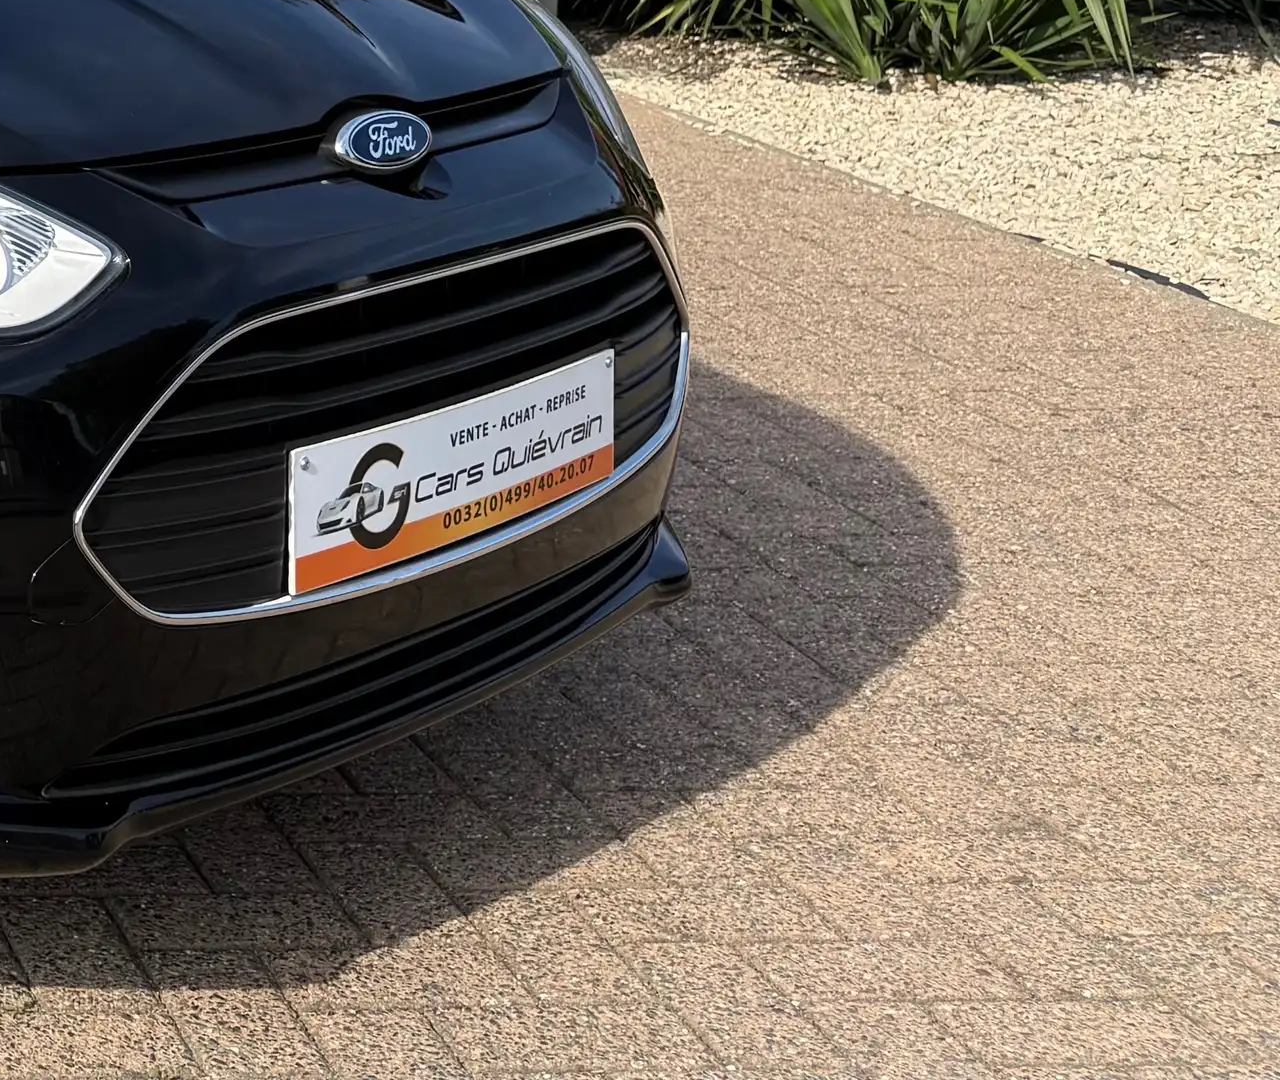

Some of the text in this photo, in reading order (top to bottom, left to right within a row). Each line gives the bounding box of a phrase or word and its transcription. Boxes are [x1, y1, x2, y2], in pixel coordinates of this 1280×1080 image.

[368, 120, 417, 159] Ford
[450, 421, 490, 448] VENTE
[500, 404, 537, 432] ACHAT
[546, 384, 587, 414] REPRISE
[414, 414, 604, 503] Cars Quiévrain
[442, 454, 595, 530] 0032(0)499/40.20.07
